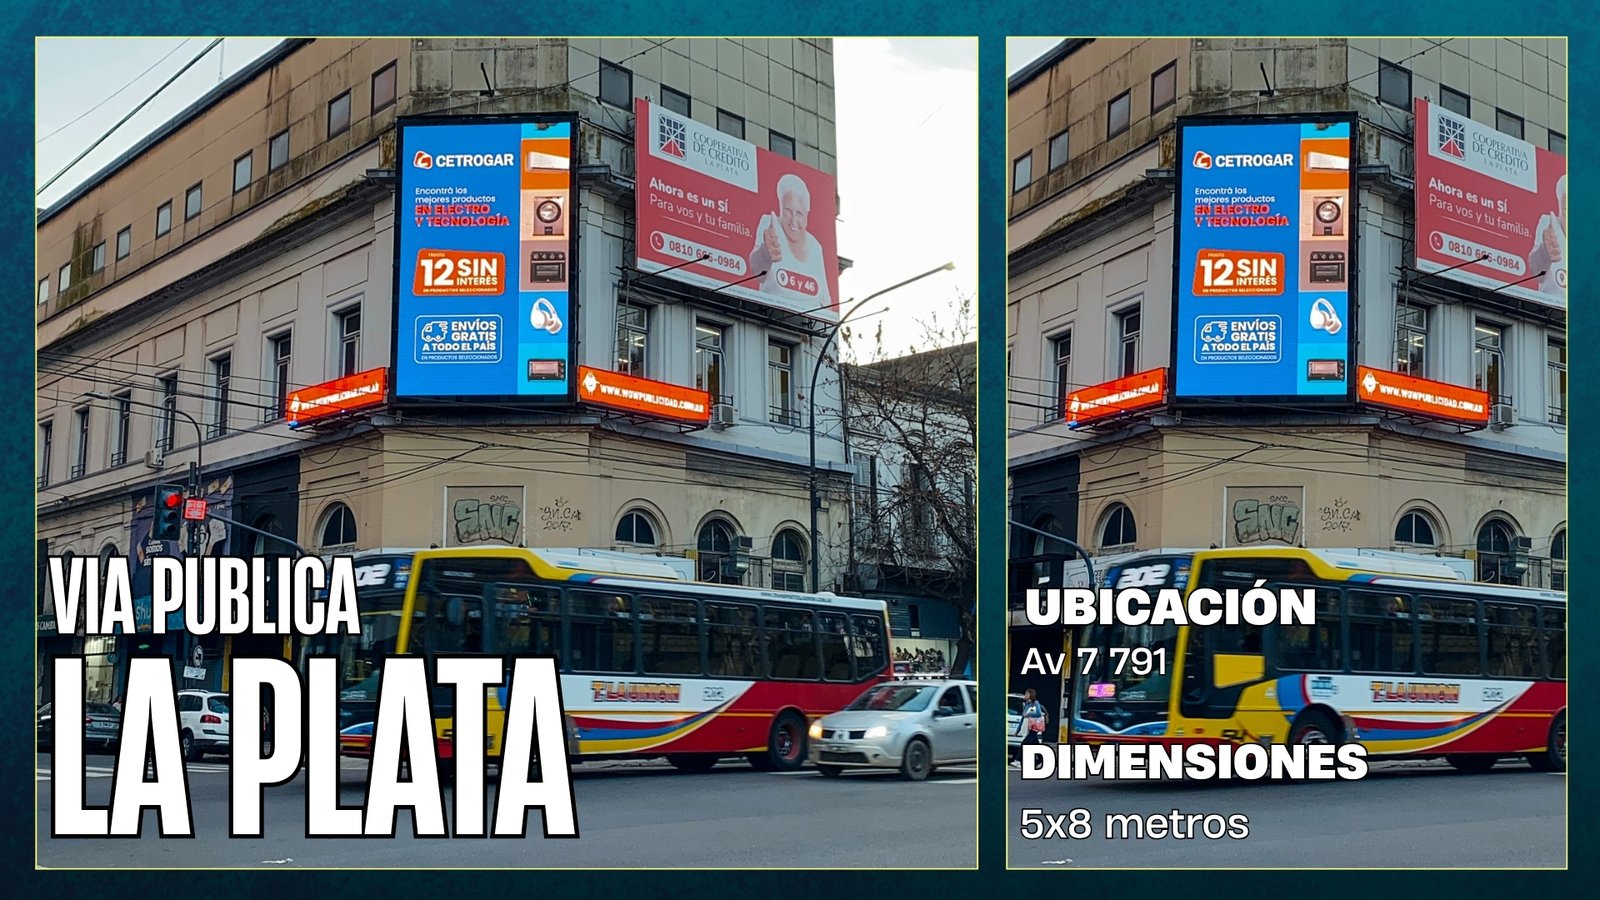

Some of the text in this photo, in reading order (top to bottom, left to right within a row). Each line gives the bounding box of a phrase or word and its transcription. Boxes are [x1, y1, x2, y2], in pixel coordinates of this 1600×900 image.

[693, 142, 706, 156] DE
[694, 131, 748, 160] COOPERATIVA
[1472, 142, 1485, 156] DE
[1473, 131, 1527, 160] COOPERATIVA
[435, 153, 514, 167] CETROGAR
[1215, 153, 1294, 167] CETROGAR
[705, 159, 739, 176] LA PLATA
[1484, 159, 1518, 176] LA PLATA
[415, 187, 454, 195] Encontrá
[649, 177, 684, 199] Ahora
[687, 191, 699, 203] es
[702, 196, 714, 209] un
[1195, 187, 1234, 195] Encontrá
[1428, 177, 1463, 199] Ahora
[1466, 191, 1478, 203] es
[1481, 196, 1493, 209] un
[415, 195, 496, 206] mejores productos
[1195, 195, 1276, 206] mejores productos
[415, 204, 490, 215] EN ELECTRO
[650, 193, 753, 238] Para vos y tu familia.
[1195, 204, 1270, 215] EN ELECTRO
[1429, 193, 1532, 238] Para vos y tu familia.
[415, 213, 510, 227] Y TECNOLOGÍA
[1195, 213, 1290, 227] Y TECNOLOGÍA
[669, 240, 693, 258] 0810
[1448, 240, 1472, 258] 0810
[421, 258, 498, 286] 12 SIN
[1201, 258, 1278, 286] 12 SIN
[456, 275, 498, 286] INTERÉS
[790, 275, 815, 292] 6 y 46
[1236, 275, 1278, 286] INTERÉS
[451, 318, 497, 331] ENVÍOS
[1231, 318, 1277, 331] ENVÍOS
[451, 331, 497, 341] GRATIS
[1231, 331, 1277, 341] GRATIS
[422, 341, 496, 351] A TODO EL PAÍS
[1202, 341, 1276, 351] A TODO EL PAÍS
